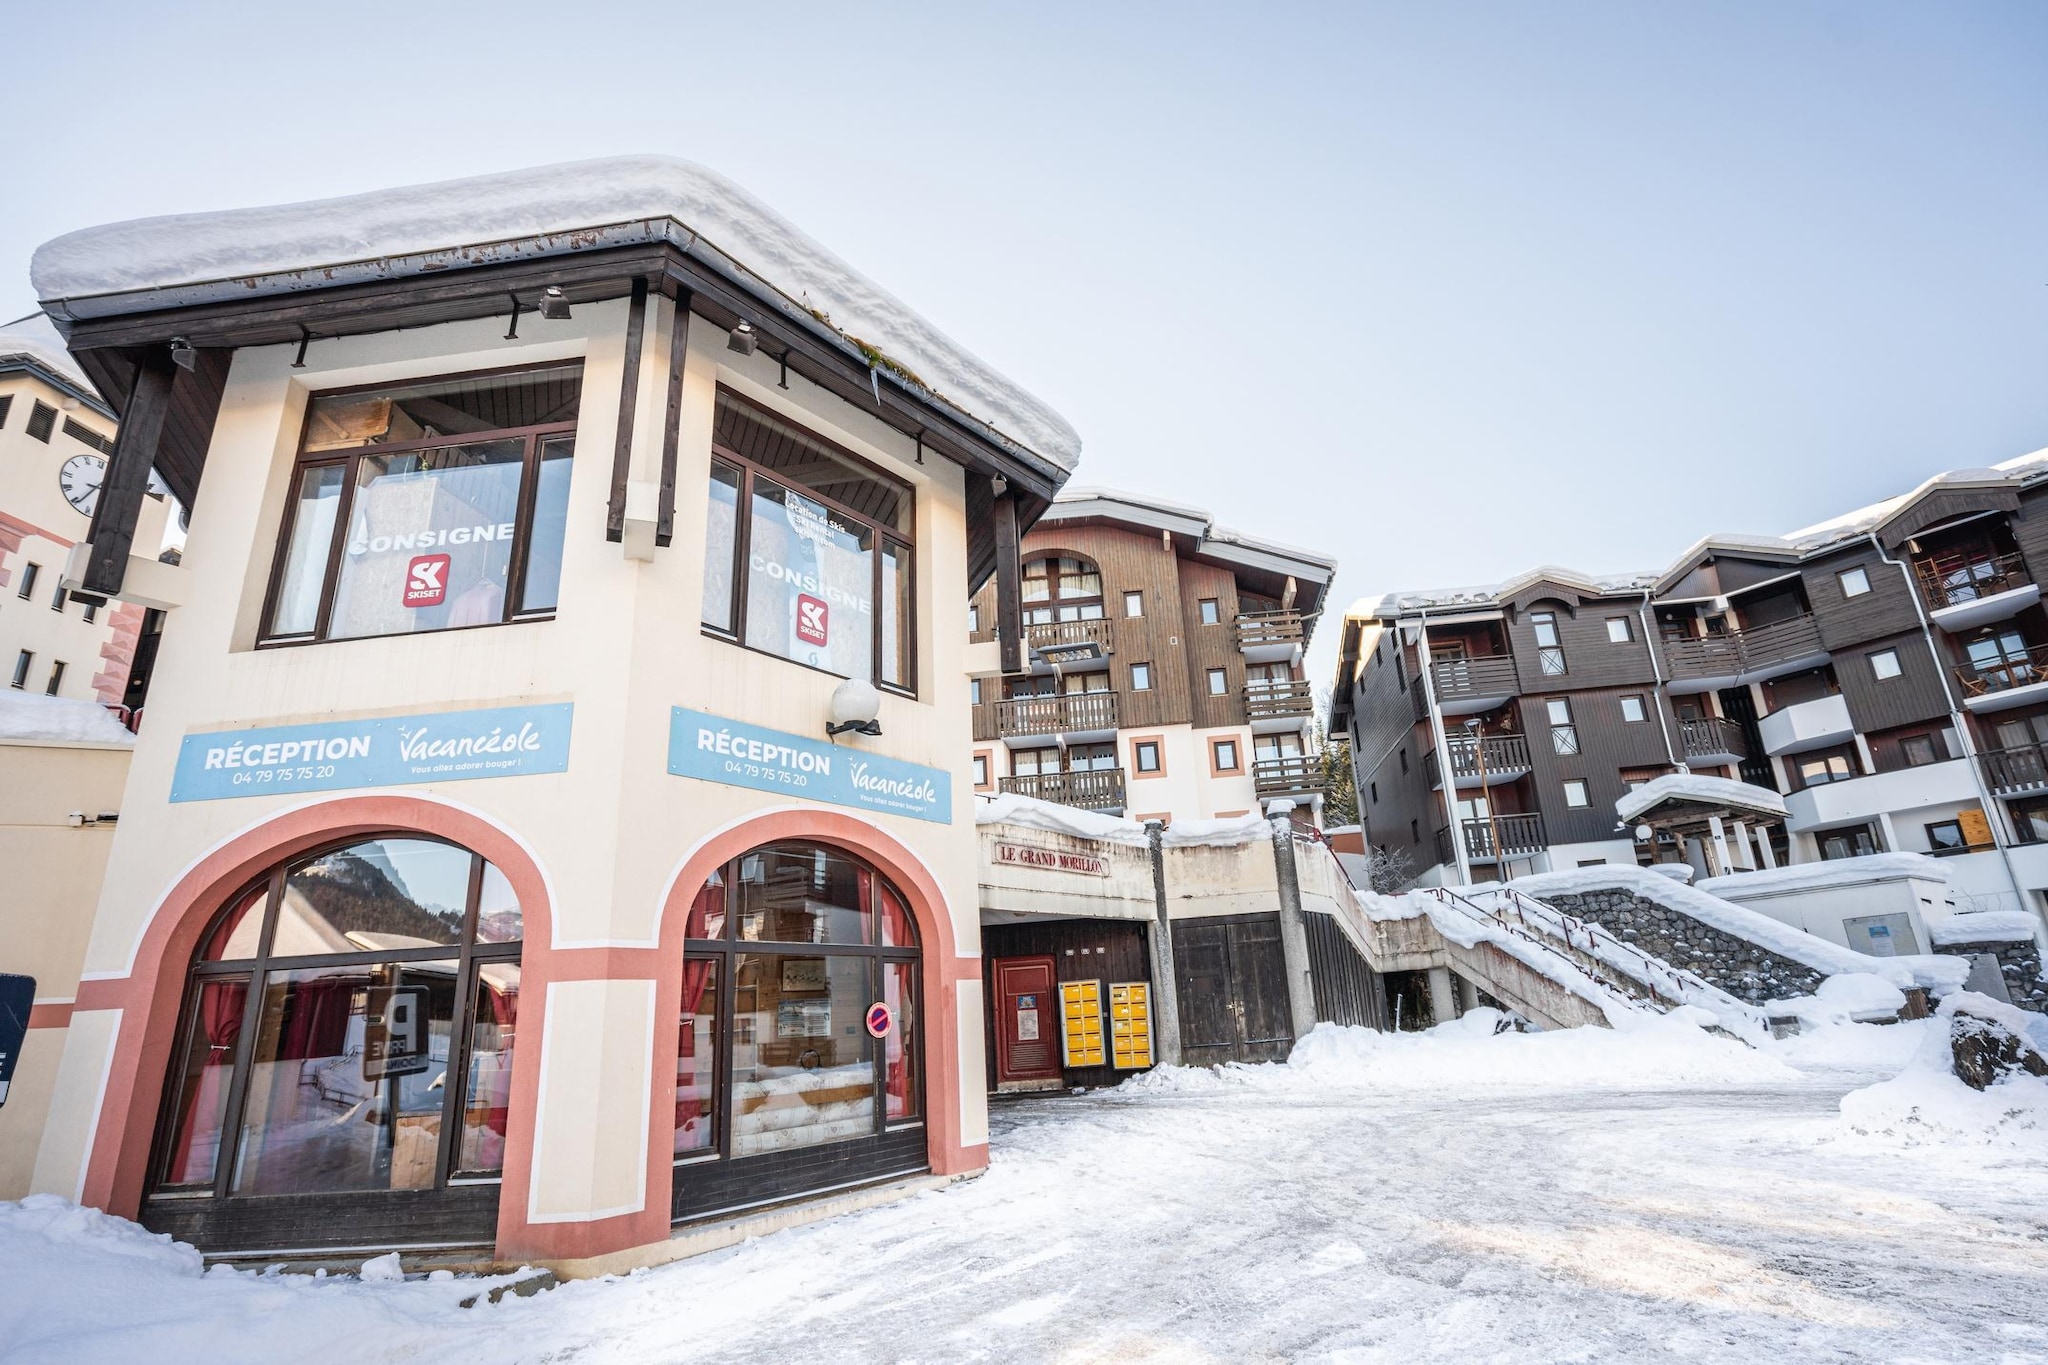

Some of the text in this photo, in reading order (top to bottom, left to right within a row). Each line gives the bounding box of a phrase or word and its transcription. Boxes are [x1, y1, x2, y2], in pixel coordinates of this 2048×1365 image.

[785, 498, 817, 521] Location
[819, 515, 829, 526] de
[350, 522, 515, 556] CONSIGNE
[407, 588, 441, 600] SKISET
[751, 554, 870, 616] CONSIGNE
[800, 625, 825, 640] SKISET
[204, 735, 371, 770] RÉCEPTION
[399, 721, 541, 762] Vacancéole
[697, 728, 830, 776] RÉCEPTION
[232, 765, 335, 785] 04 79 75 75 20
[411, 765, 432, 774] Vous
[433, 763, 454, 772] allez
[455, 761, 484, 771] adorer
[486, 759, 515, 770] bouger
[725, 760, 807, 786] 04 79 75 75 20
[850, 762, 936, 803] Vacancéole
[1001, 846, 1016, 861] LE
[1020, 849, 1056, 867] GRAND
